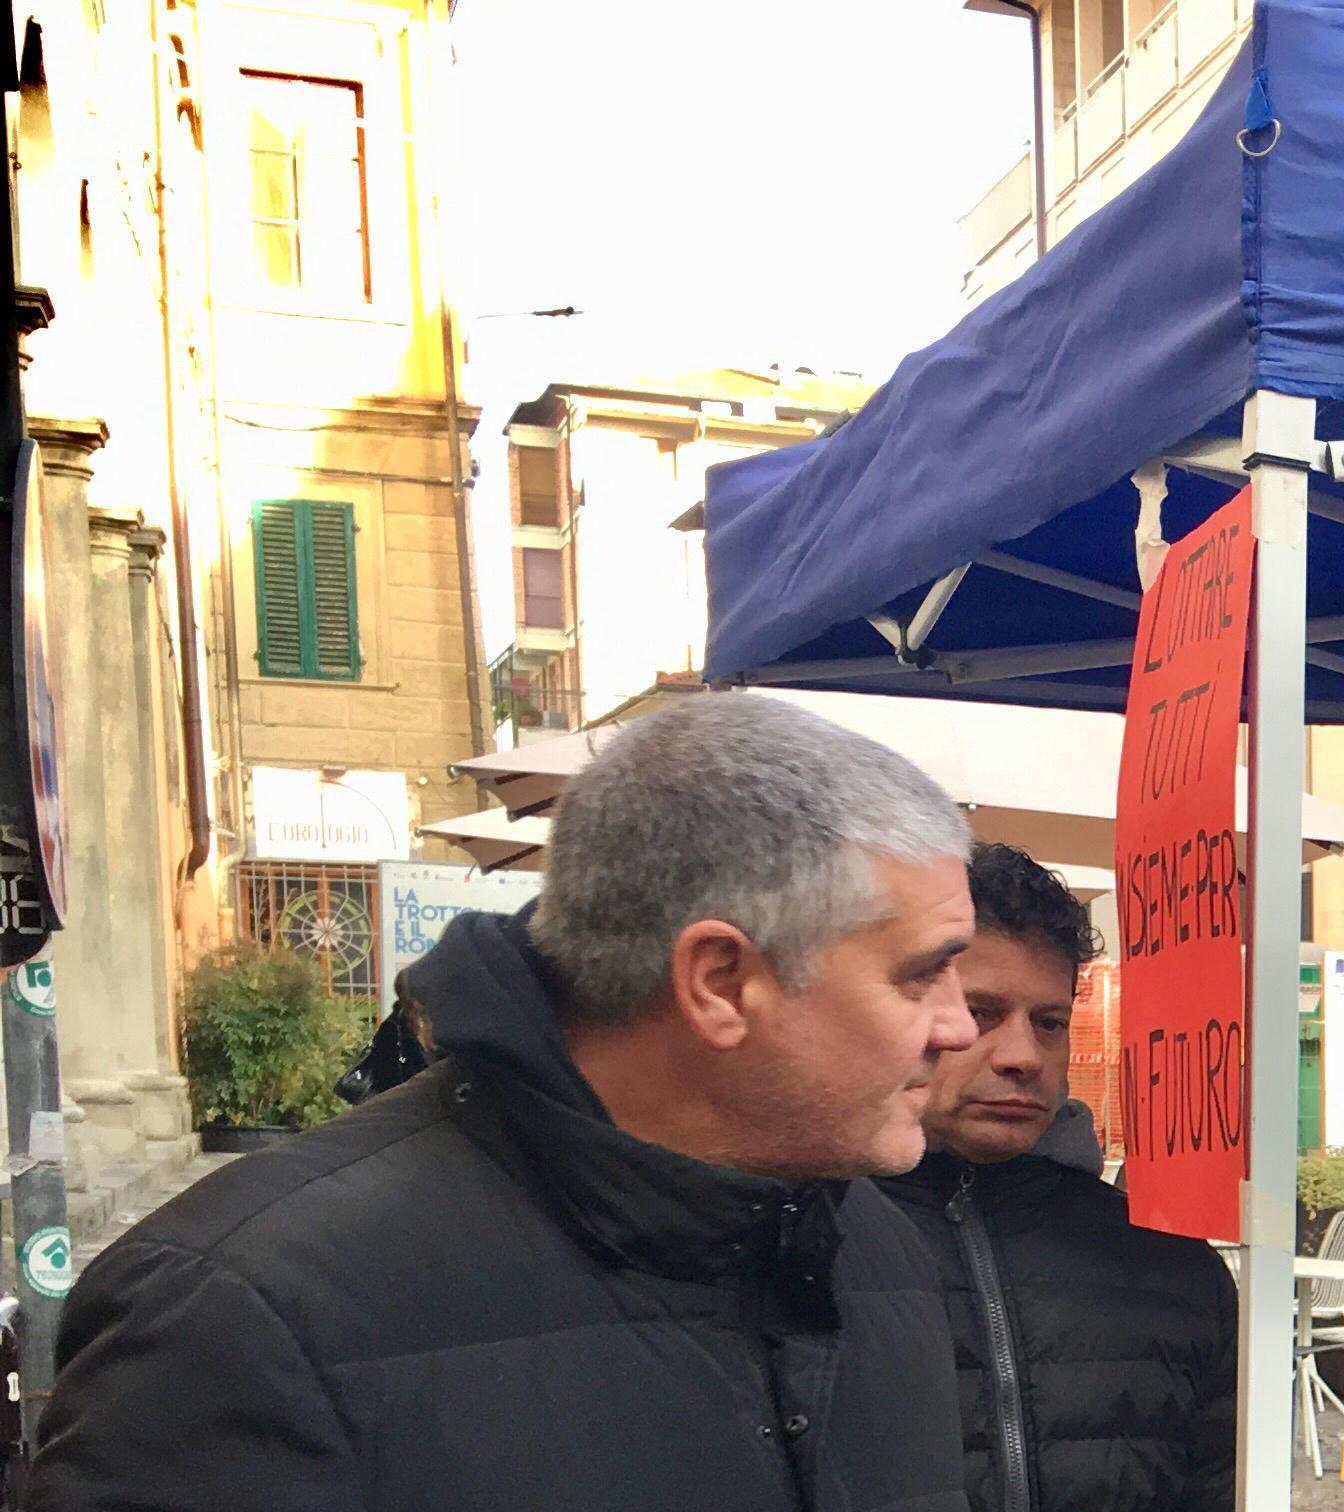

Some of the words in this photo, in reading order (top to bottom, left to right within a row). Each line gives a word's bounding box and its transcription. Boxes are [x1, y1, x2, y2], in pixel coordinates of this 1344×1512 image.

[1141, 659, 1223, 804] TUTTI
[393, 886, 418, 904] LA
[394, 921, 405, 936] E
[411, 921, 426, 938] IL
[1196, 828, 1238, 939] PER
[1148, 1018, 1243, 1162] FUTURO
